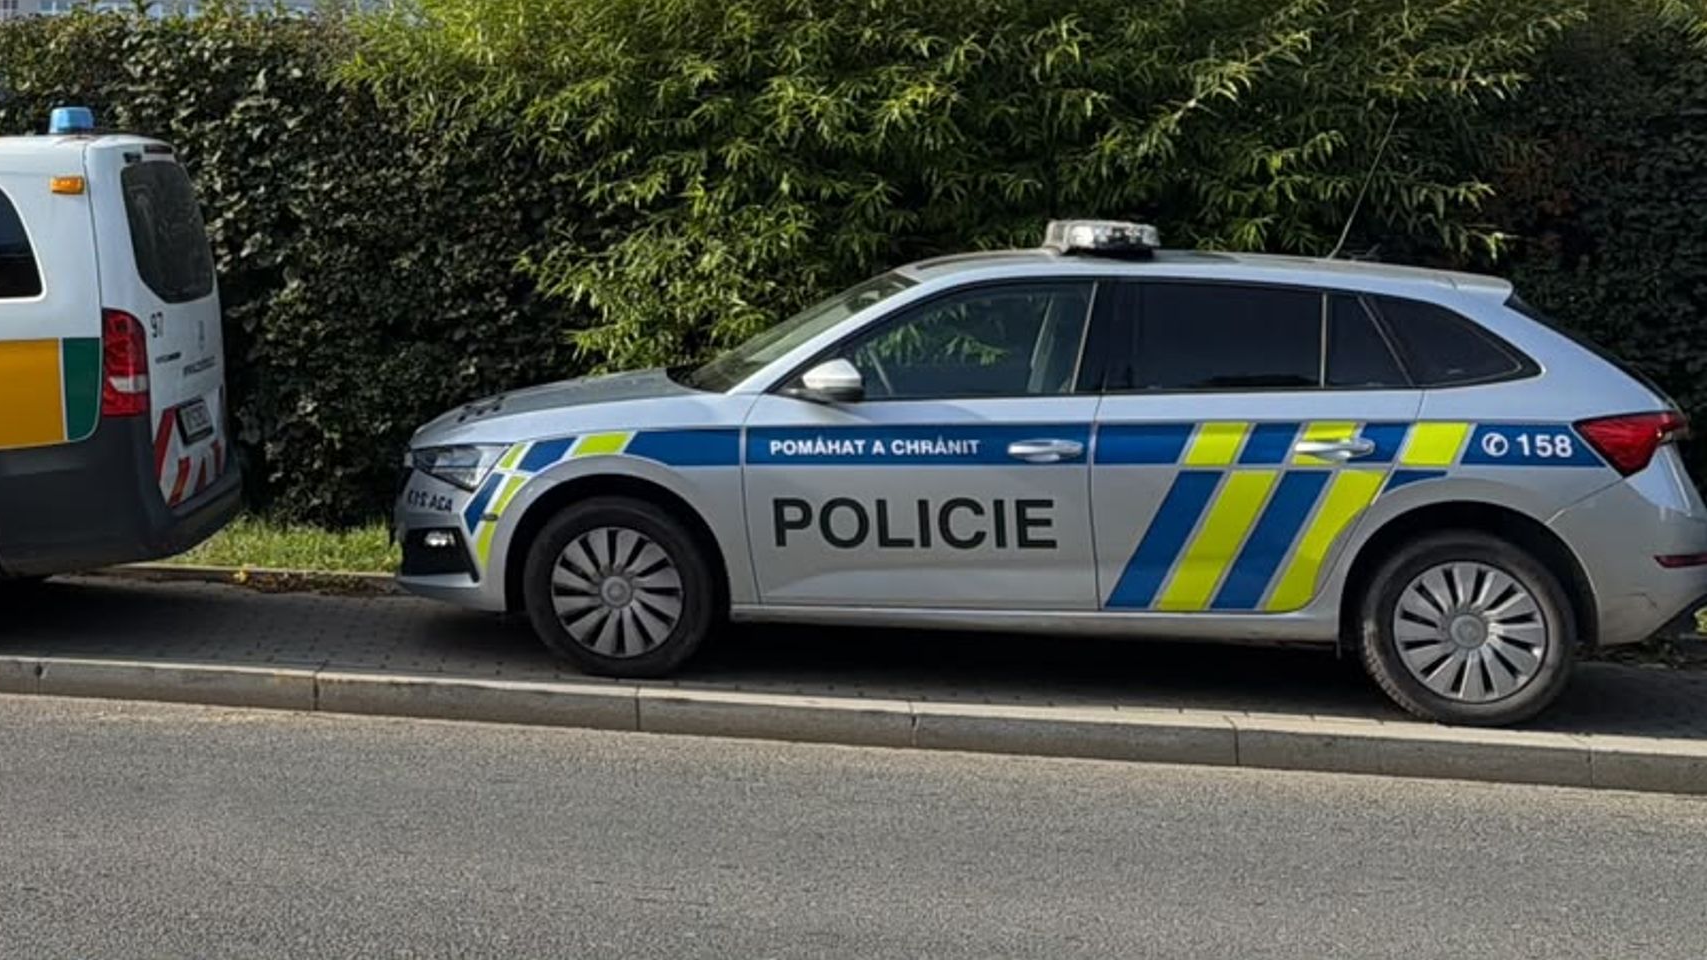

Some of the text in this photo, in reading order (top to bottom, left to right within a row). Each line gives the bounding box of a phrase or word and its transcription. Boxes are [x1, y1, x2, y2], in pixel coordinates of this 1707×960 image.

[769, 435, 981, 456] POMÁHAT A CHRÁNIT
[1515, 433, 1573, 458] 158
[772, 496, 1058, 550] POLICIE
